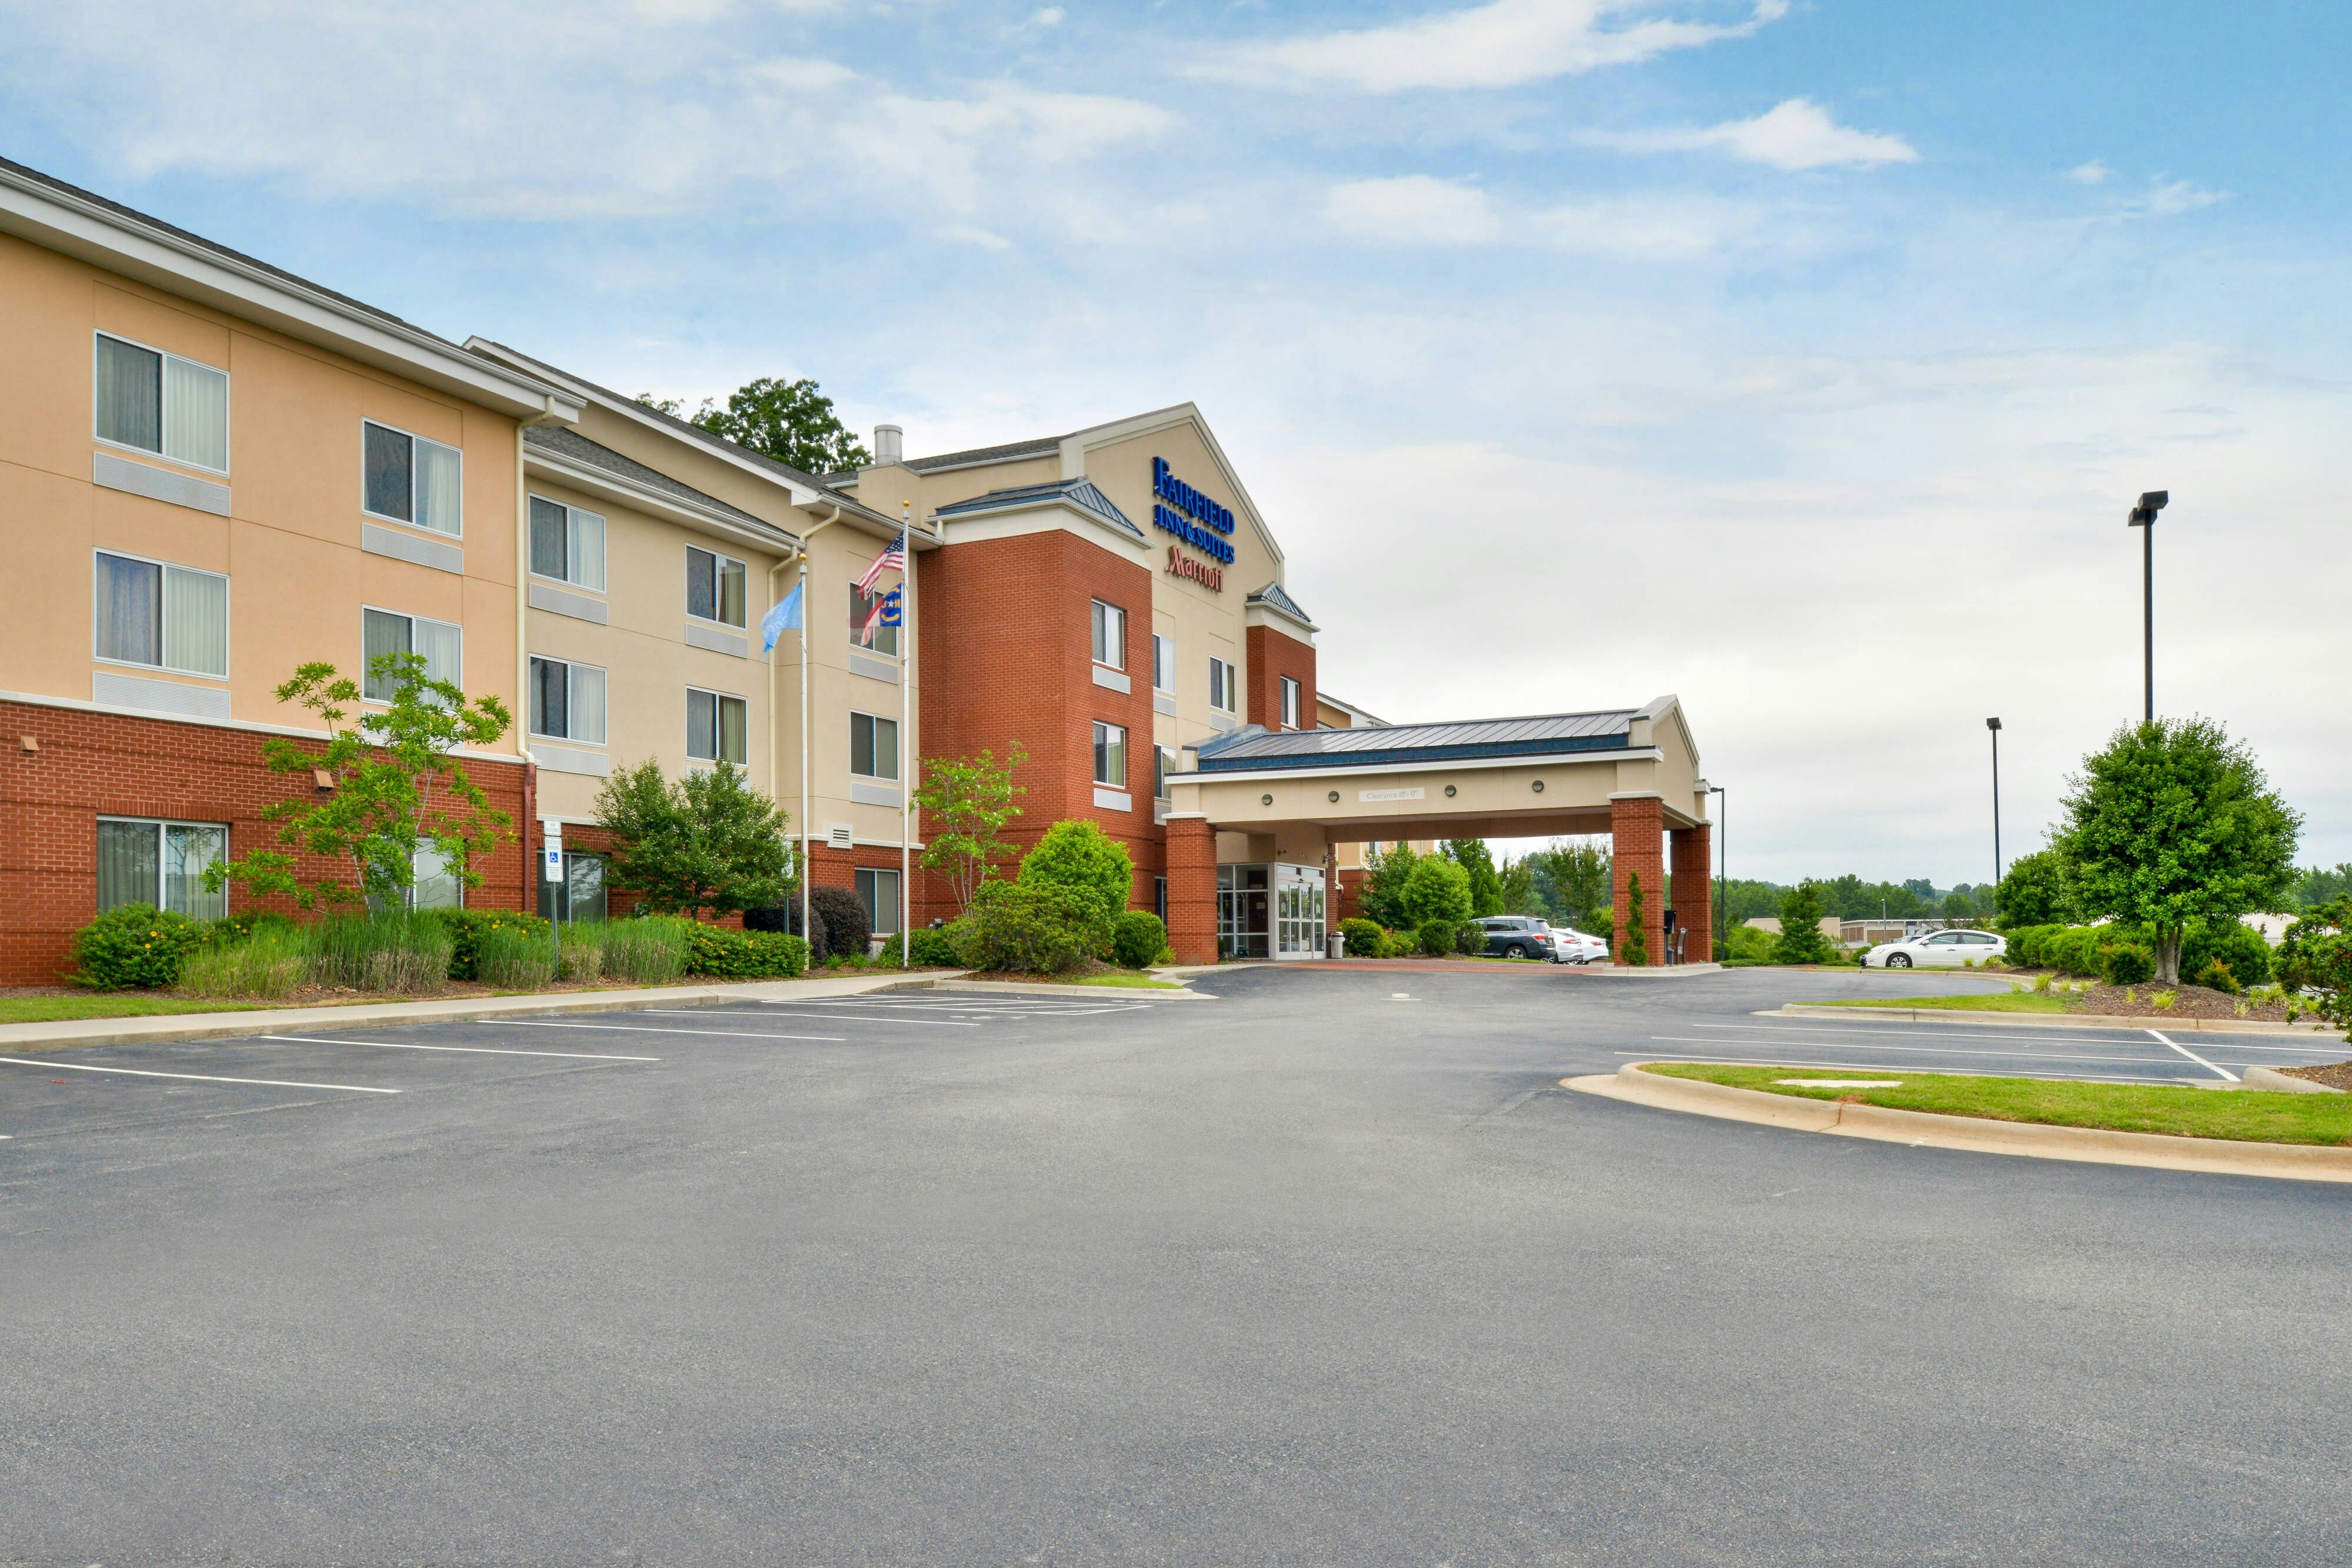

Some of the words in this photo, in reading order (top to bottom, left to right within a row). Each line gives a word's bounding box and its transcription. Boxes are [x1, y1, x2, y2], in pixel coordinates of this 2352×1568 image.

[1153, 456, 1235, 534] FAIRFIELD
[1153, 504, 1185, 536] INN
[1185, 521, 1196, 543] &
[1196, 527, 1235, 564] SUITES
[1168, 544, 1224, 593] Marriott
